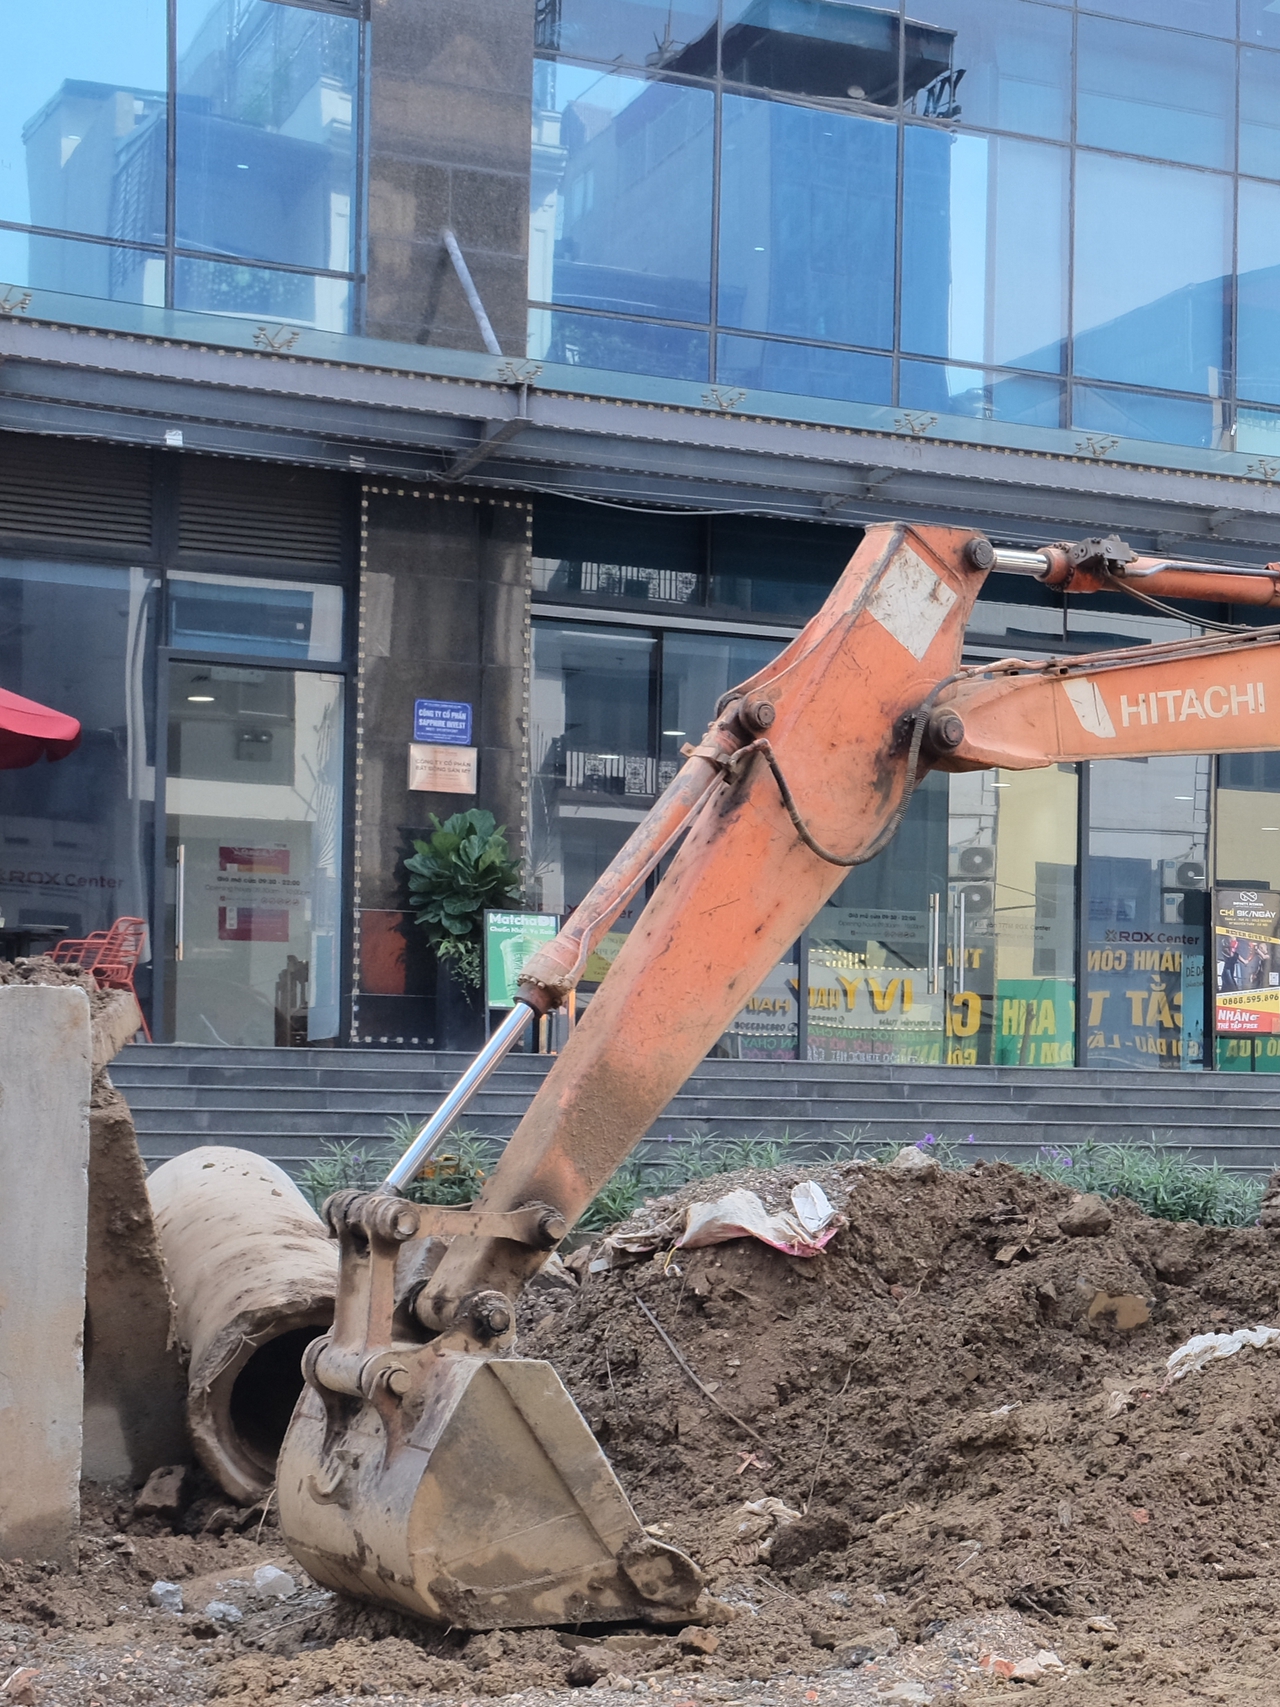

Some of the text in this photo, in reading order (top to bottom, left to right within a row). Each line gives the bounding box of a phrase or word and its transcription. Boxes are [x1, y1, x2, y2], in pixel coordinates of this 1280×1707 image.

[1120, 682, 1265, 727] HITACHI
[65, 874, 124, 888] Center
[1119, 931, 1200, 945] ROX Center
